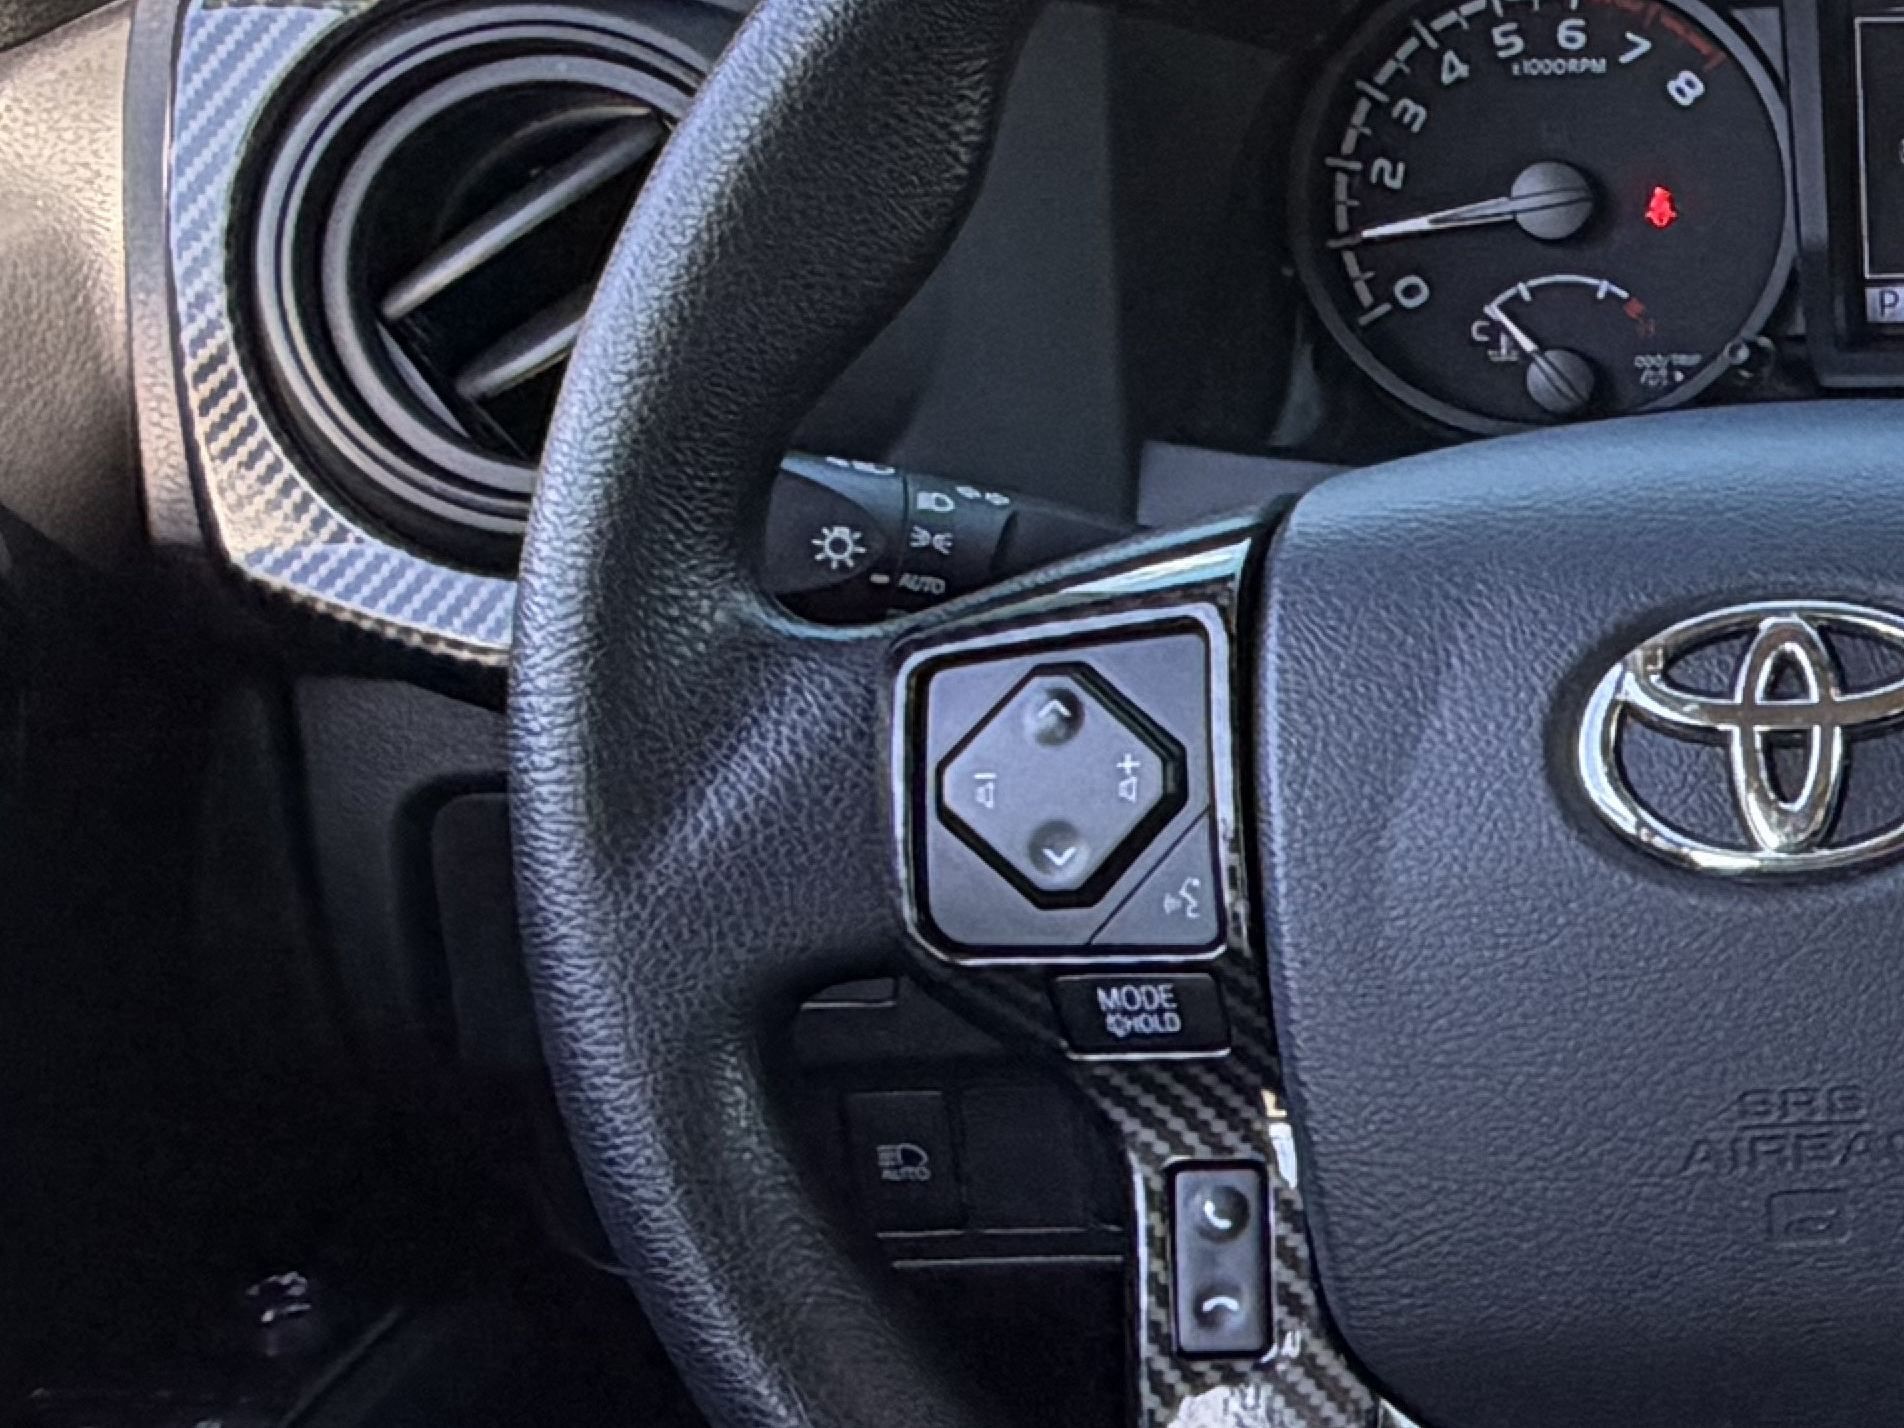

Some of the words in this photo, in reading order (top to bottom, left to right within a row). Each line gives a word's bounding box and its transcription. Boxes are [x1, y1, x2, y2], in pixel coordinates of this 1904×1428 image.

[1491, 22, 1524, 59] 5
[1557, 18, 1587, 50] 6
[1618, 31, 1652, 64] 7
[1440, 49, 1470, 85] 4
[1666, 70, 1705, 106] 8
[1391, 97, 1427, 133] 3
[1370, 158, 1405, 190] 2
[1393, 274, 1430, 310] 0
[1879, 289, 1900, 318] P
[1471, 320, 1491, 342] C
[899, 573, 946, 595] AUTO
[1097, 982, 1177, 1011] MODE
